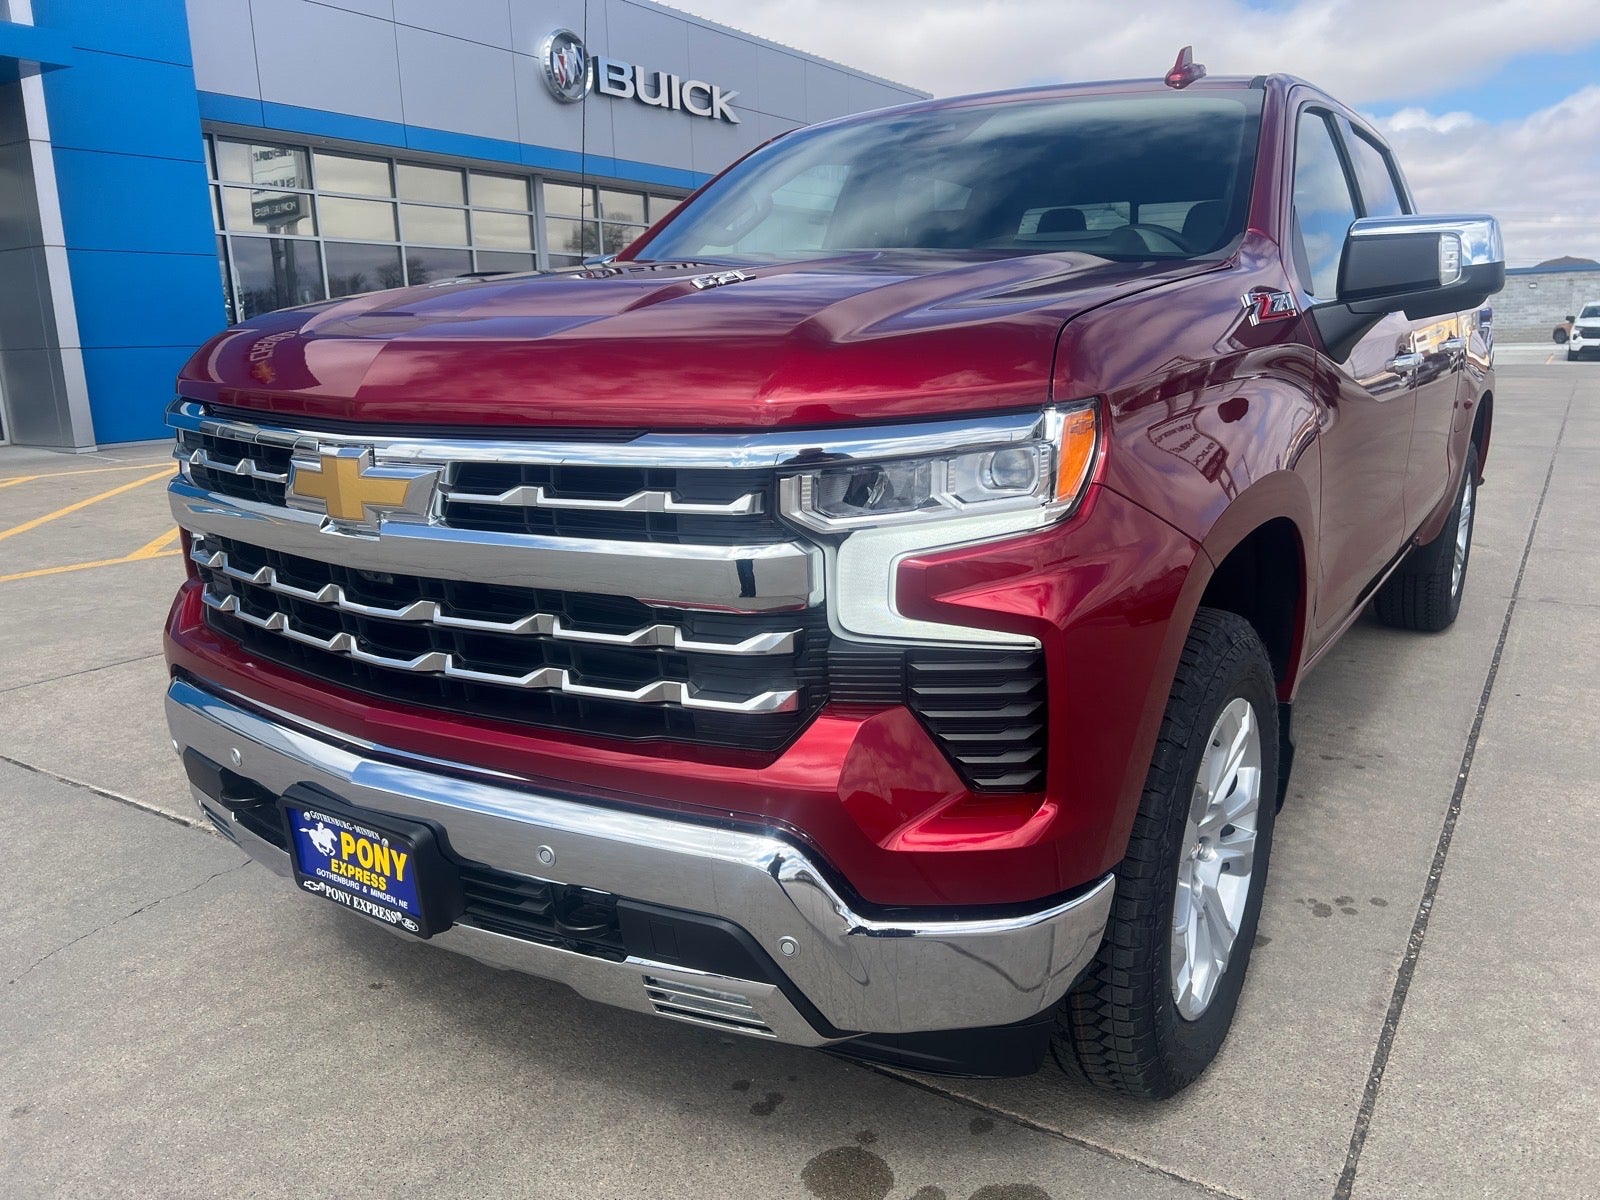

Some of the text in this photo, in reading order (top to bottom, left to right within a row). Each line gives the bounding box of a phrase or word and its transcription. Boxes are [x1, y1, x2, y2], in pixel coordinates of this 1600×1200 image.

[593, 55, 741, 124] BUICK
[331, 858, 387, 891] EXPRESS
[340, 831, 408, 882] PONY
[316, 867, 360, 890] GOTHENBURG
[370, 889, 398, 906] MINDEN,
[398, 899, 408, 909] NE
[325, 885, 397, 924] PONY EXPRESS
